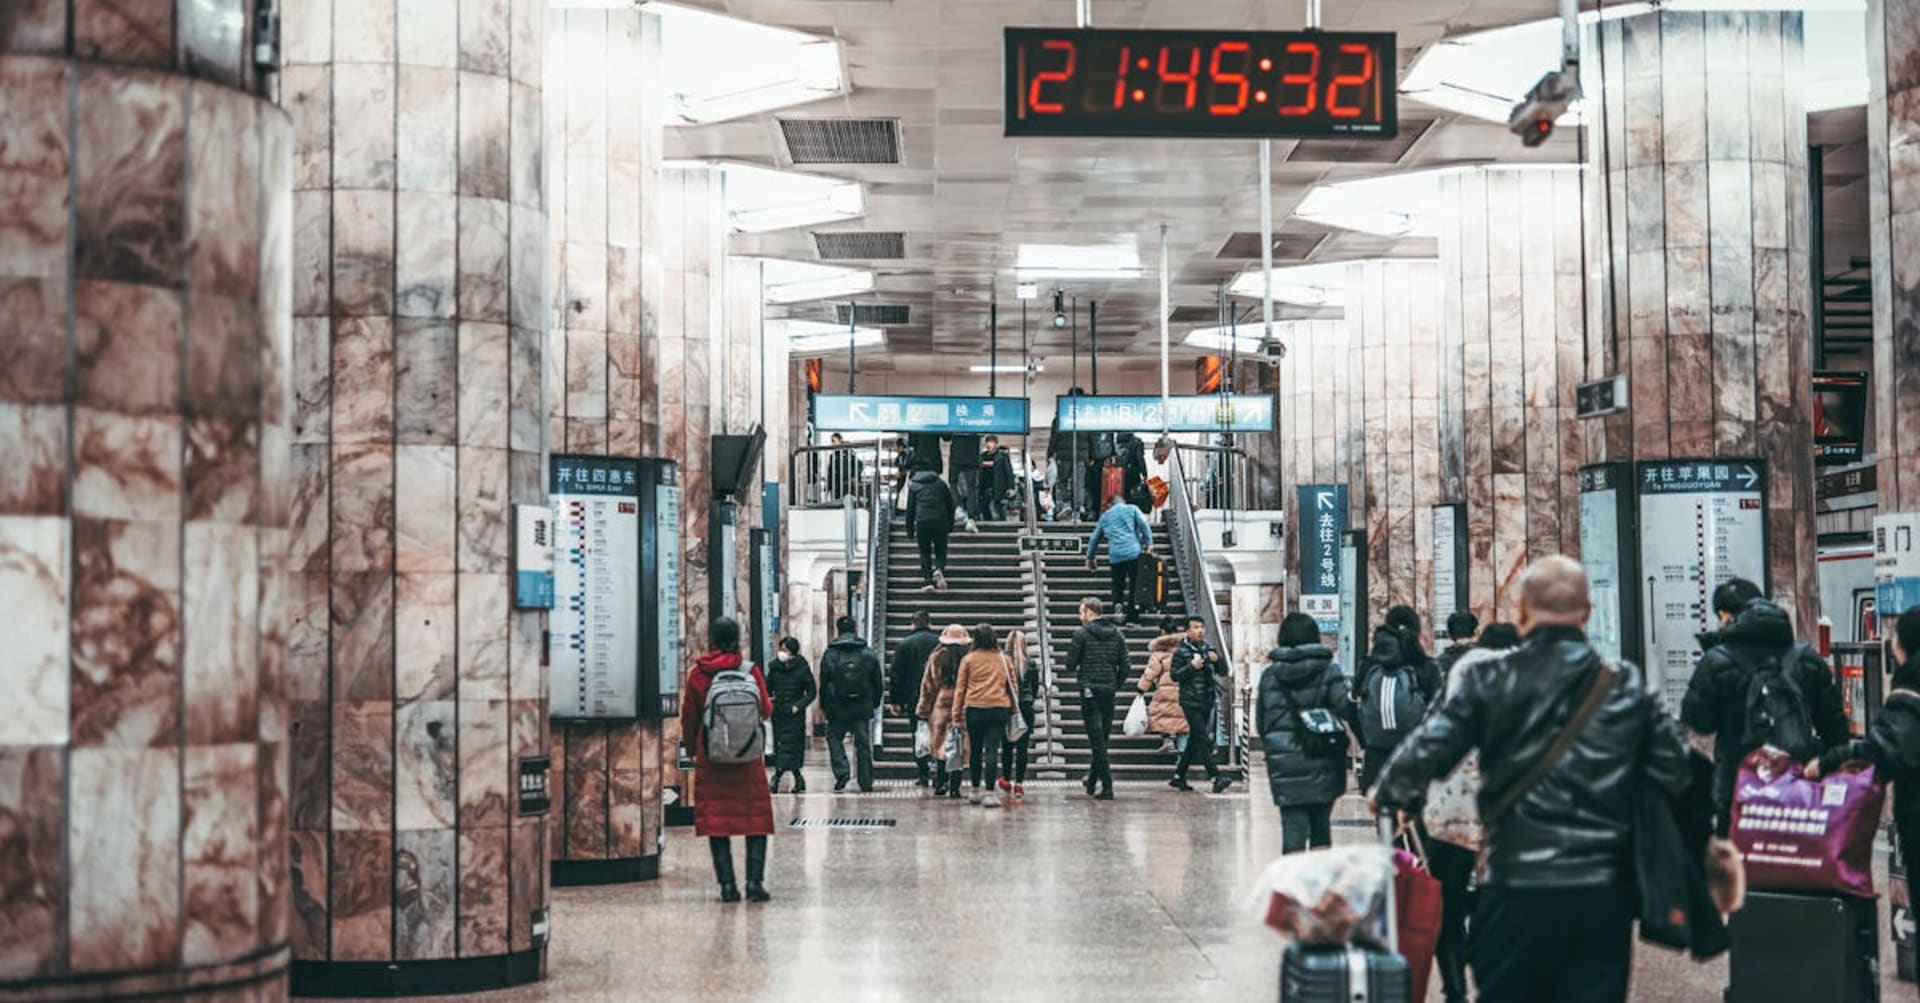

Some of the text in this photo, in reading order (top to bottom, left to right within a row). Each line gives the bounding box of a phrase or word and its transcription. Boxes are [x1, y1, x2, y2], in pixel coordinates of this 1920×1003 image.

[1029, 40, 1375, 116] 21:45:32
[557, 467, 637, 485] 开往四惠东
[1645, 465, 1729, 483] 开往苹果园
[1318, 512, 1336, 588] 去往2号线
